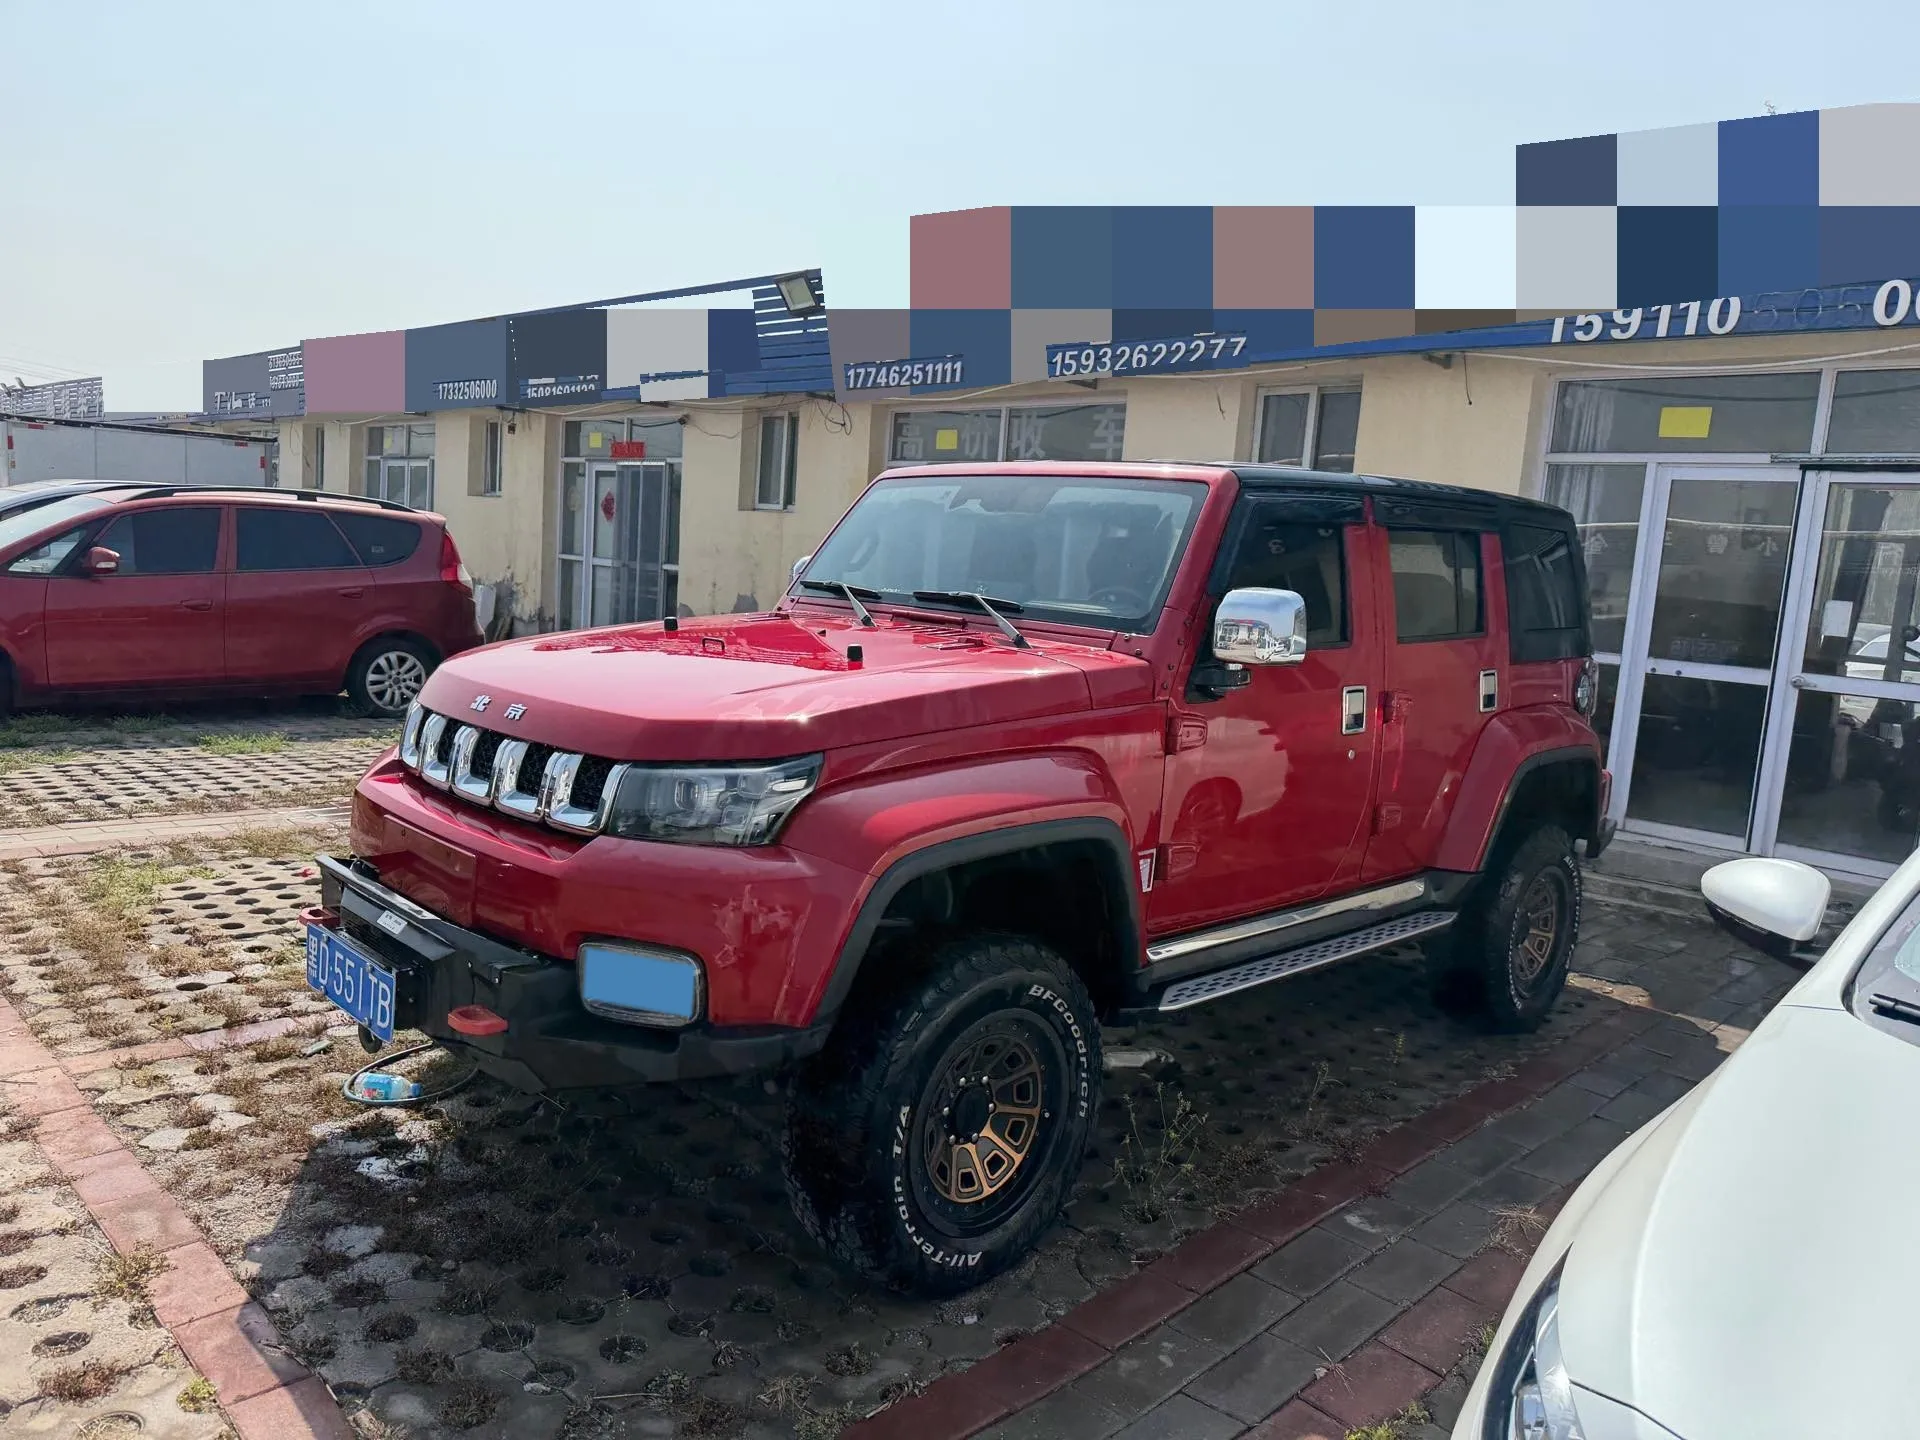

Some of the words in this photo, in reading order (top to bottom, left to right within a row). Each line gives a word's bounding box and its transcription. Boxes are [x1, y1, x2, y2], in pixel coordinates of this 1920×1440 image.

[1051, 336, 1248, 376] 15932622277
[439, 380, 498, 400] 17332506000
[847, 361, 963, 389] 17746251111
[470, 694, 528, 721] 北京
[1027, 984, 1089, 1118] BFGoodrich
[892, 1105, 911, 1159] T/A
